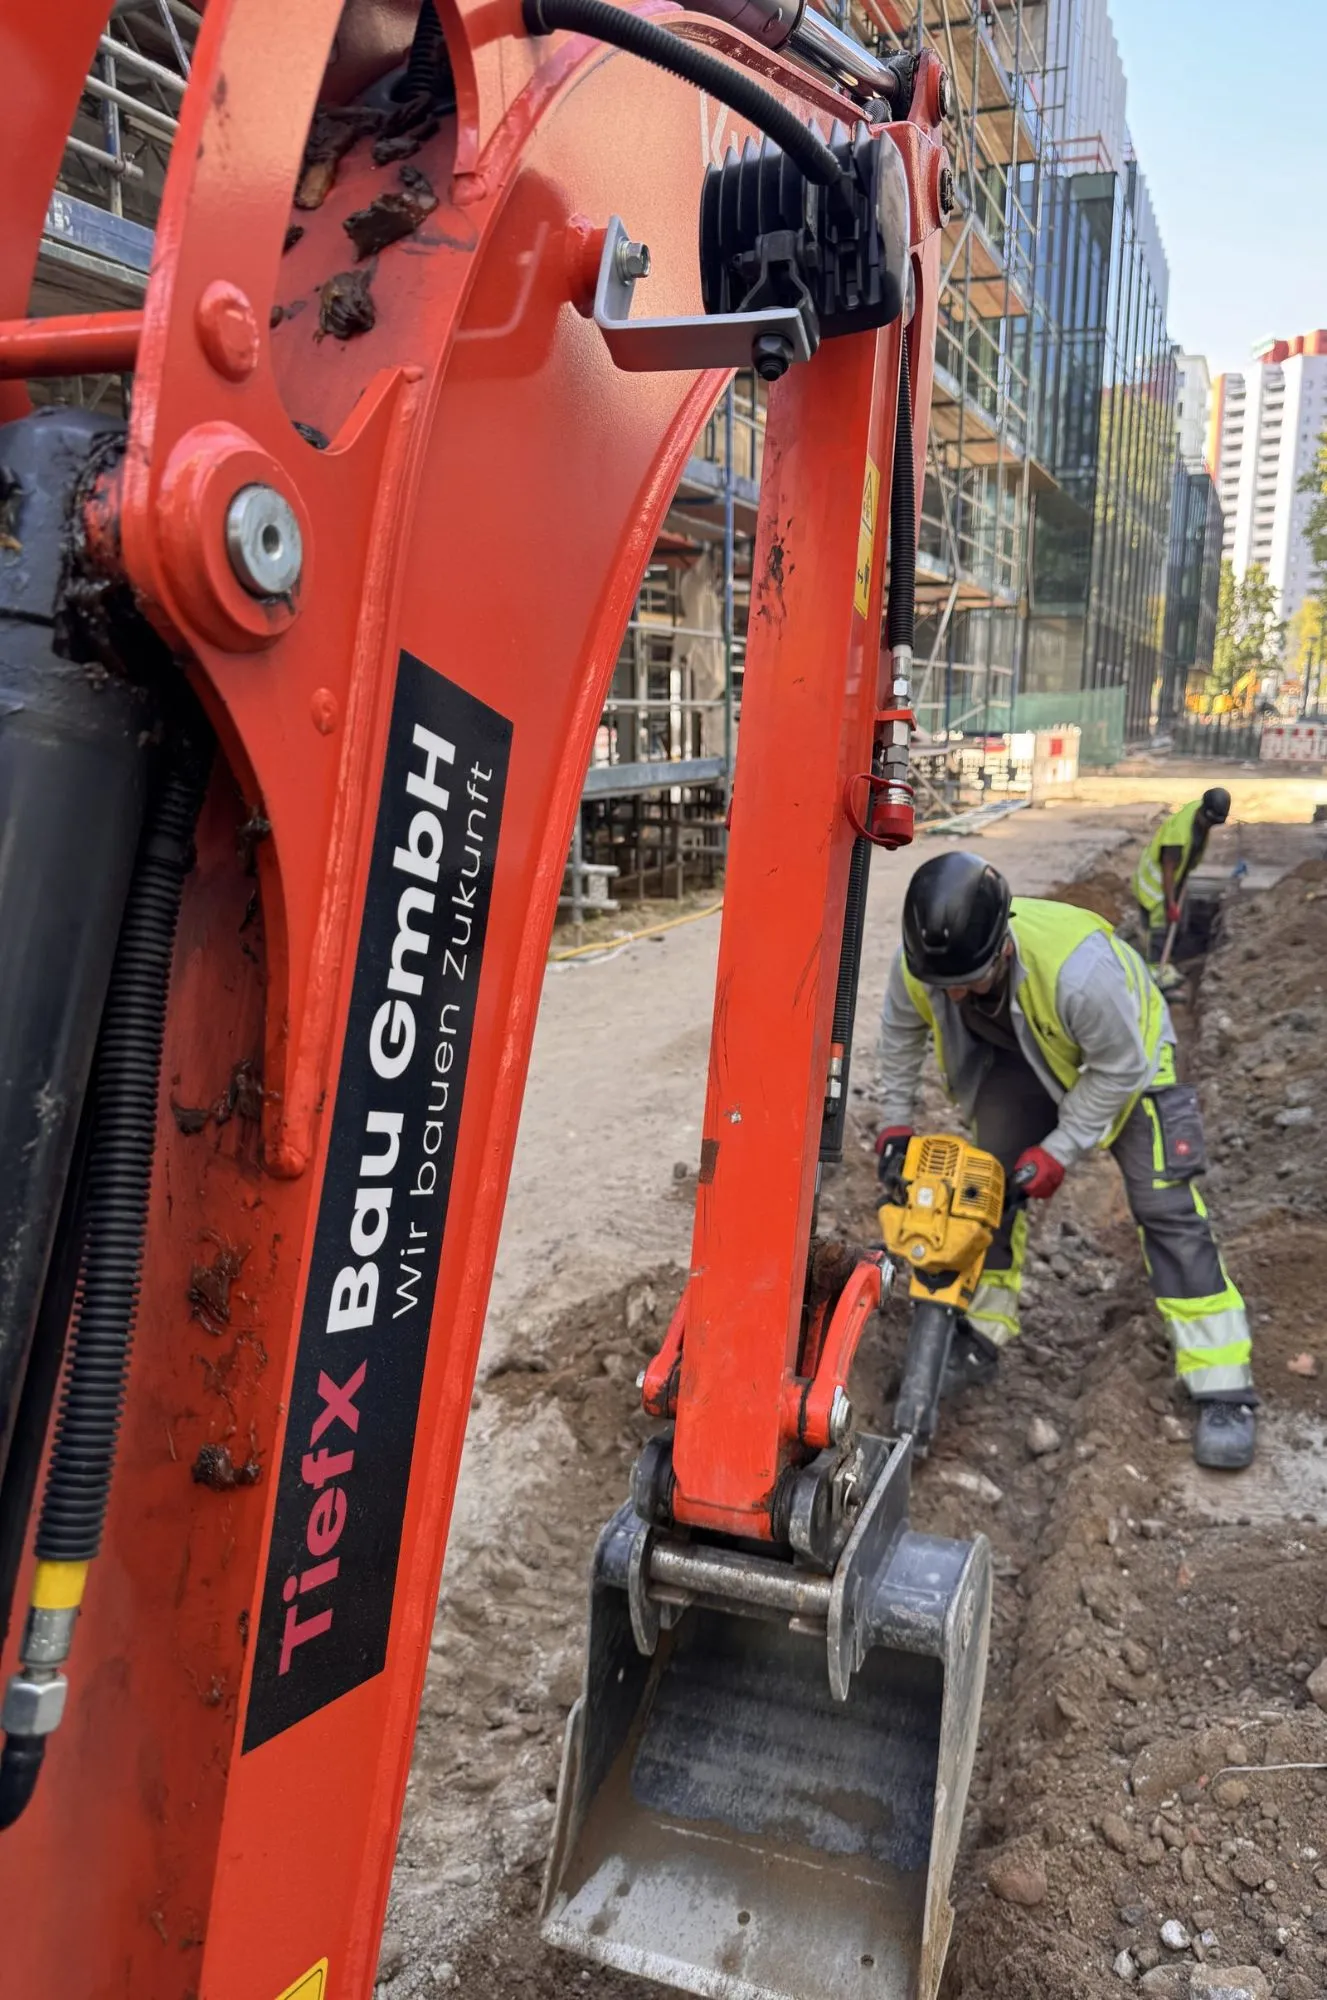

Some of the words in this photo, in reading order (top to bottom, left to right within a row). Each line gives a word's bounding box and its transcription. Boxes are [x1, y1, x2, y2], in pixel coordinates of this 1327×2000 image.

[442, 761, 494, 981] Zukunft
[277, 1359, 368, 1676] TiefX
[325, 1110, 405, 1334] Bau
[369, 723, 458, 1080] GmbH
[409, 1003, 461, 1196] bauen
[392, 1221, 428, 1320] Wir
